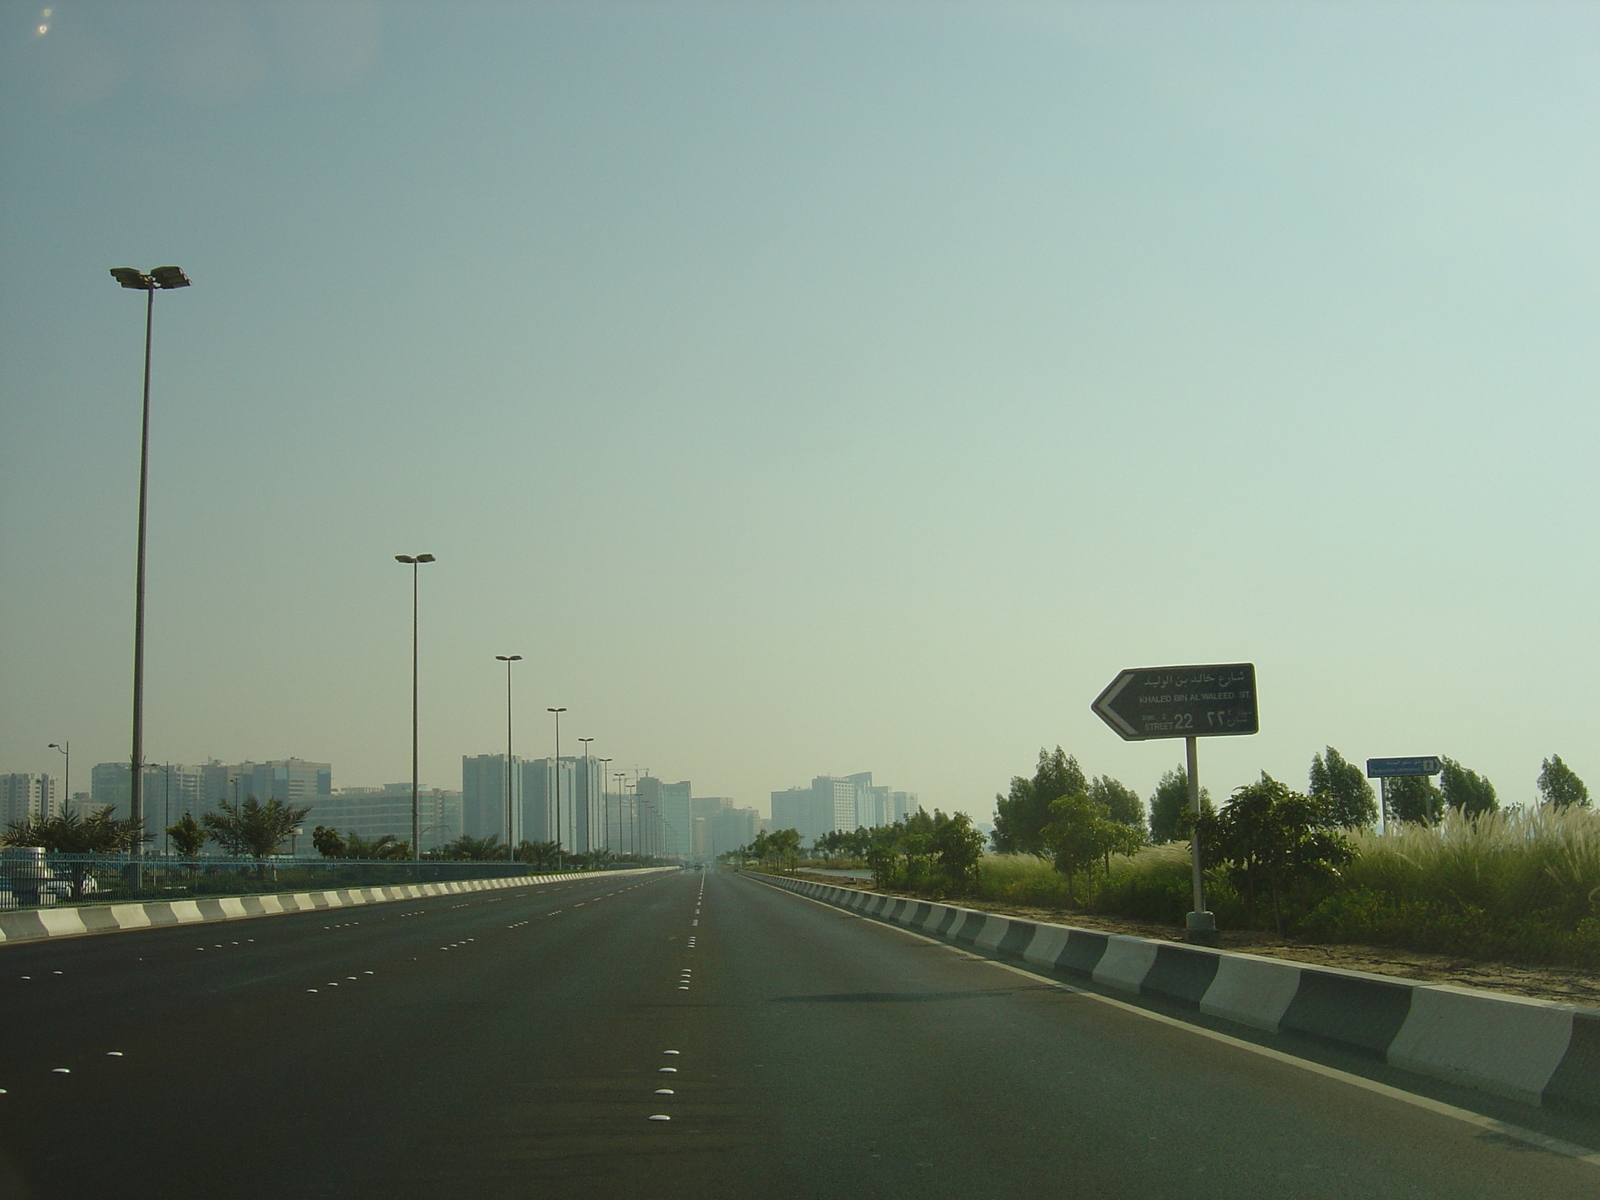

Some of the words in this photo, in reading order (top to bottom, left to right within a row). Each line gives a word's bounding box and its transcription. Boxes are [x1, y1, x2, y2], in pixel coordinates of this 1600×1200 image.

[1144, 674, 1172, 689] الوليد
[1175, 678, 1187, 687] بن
[1191, 674, 1215, 683] خالد
[1219, 671, 1245, 687] شارع
[1139, 694, 1171, 704] KHALED
[1174, 693, 1187, 702] BIN
[1190, 693, 1200, 701] AL
[1202, 692, 1234, 700] WALEED
[1145, 721, 1174, 731] STREET
[1174, 713, 1193, 729] 22
